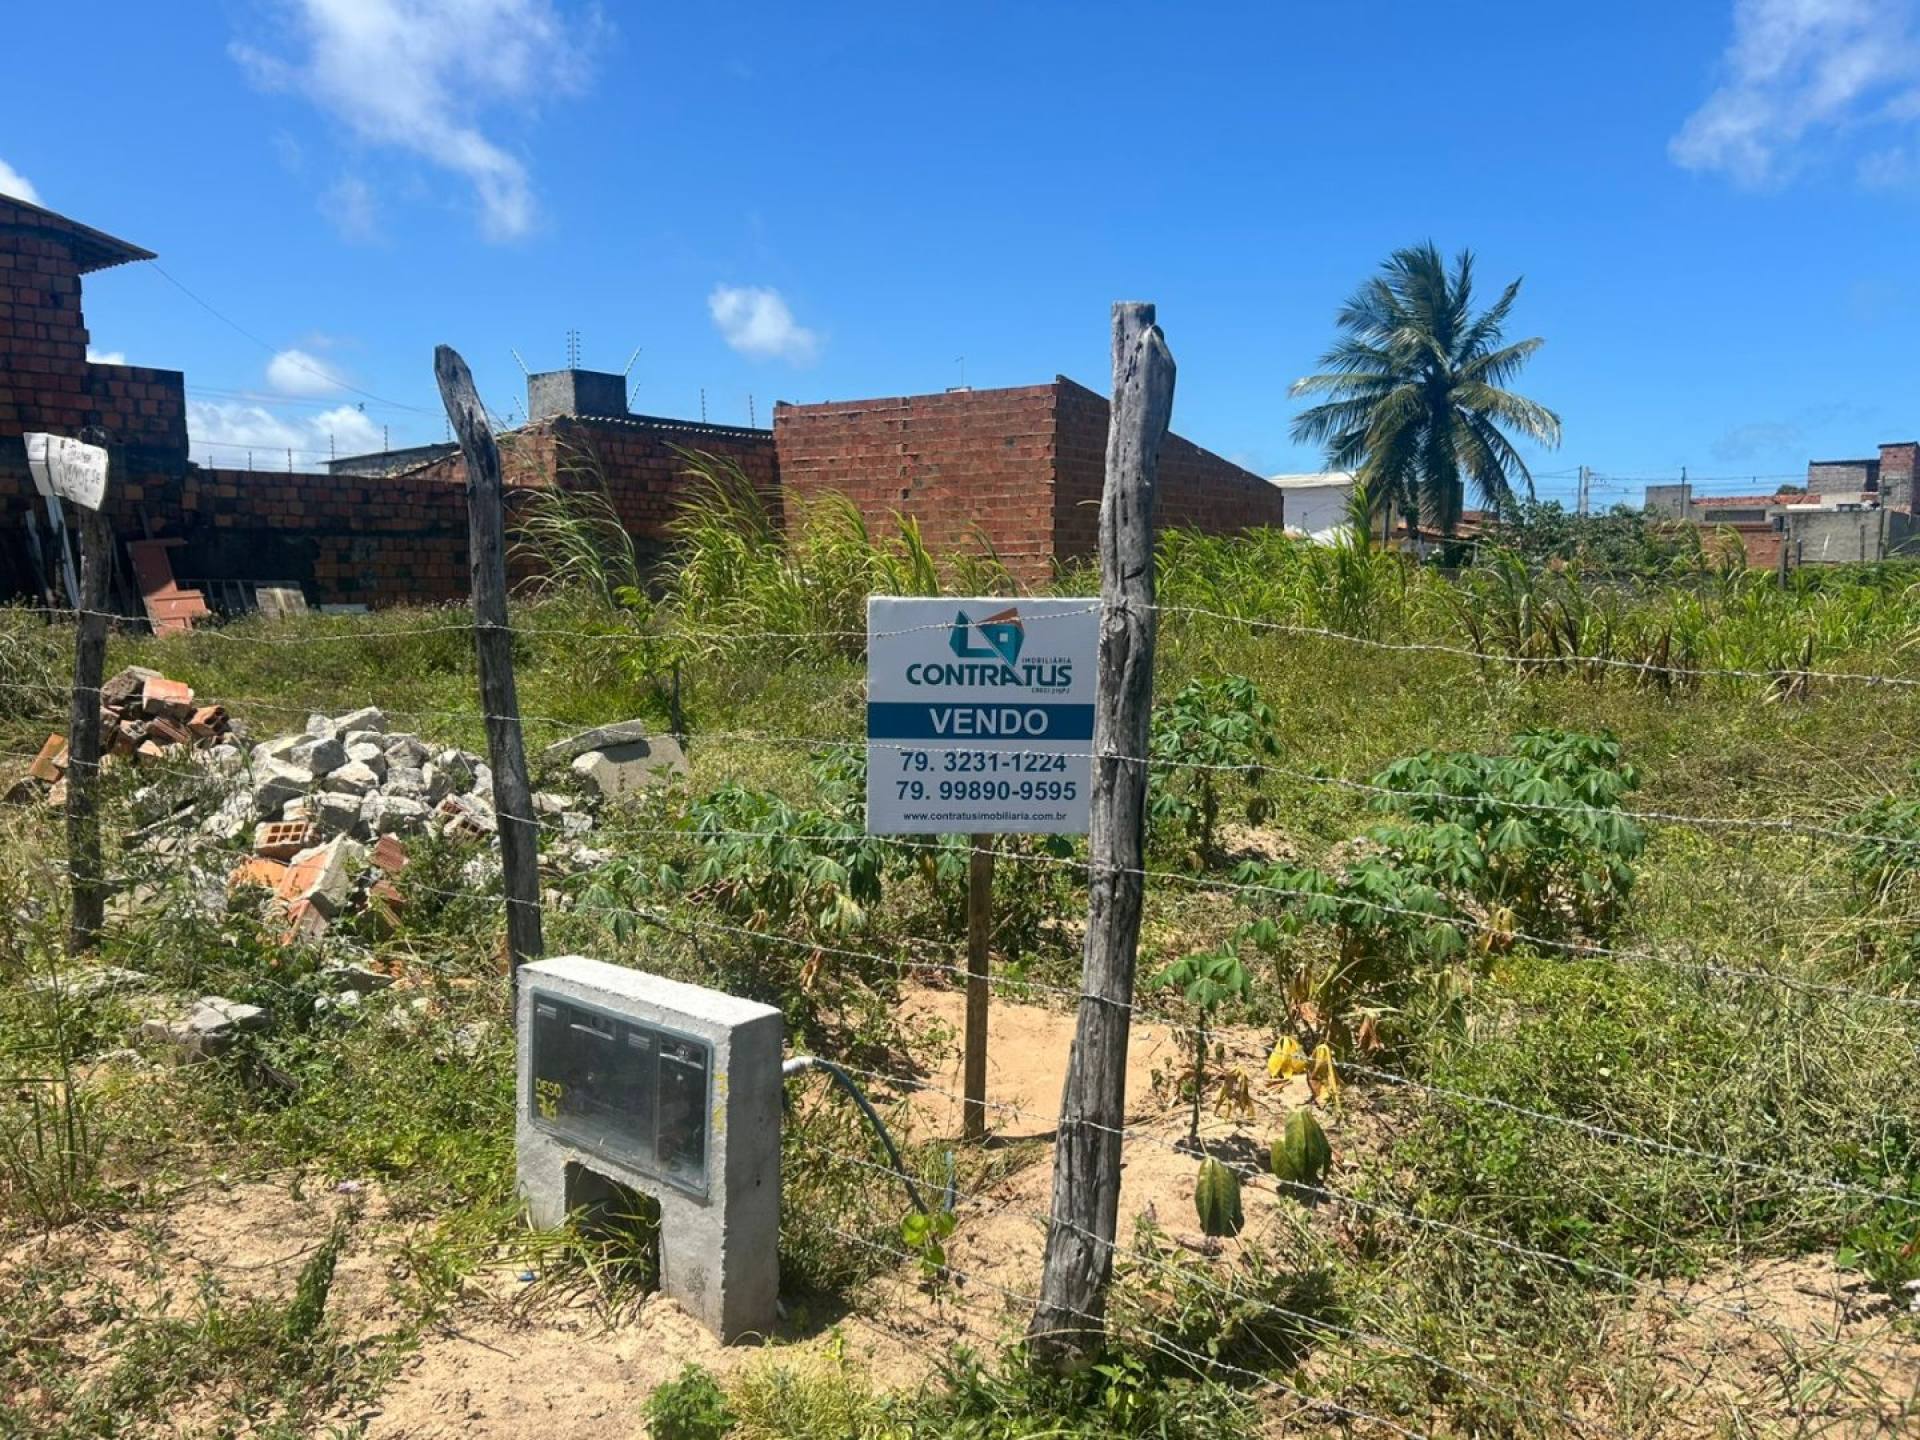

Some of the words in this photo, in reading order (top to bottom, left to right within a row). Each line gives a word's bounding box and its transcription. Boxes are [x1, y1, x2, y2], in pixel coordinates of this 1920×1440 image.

[906, 663, 1073, 687] CONTRATUS
[929, 708, 1049, 735] VENDO
[900, 752, 935, 772] 79.
[943, 751, 1067, 773] 3231-1224
[896, 781, 931, 800] 79.
[939, 781, 1077, 801] 99890-9595
[903, 811, 1067, 821] www.contratusimobiliaria.com.br
